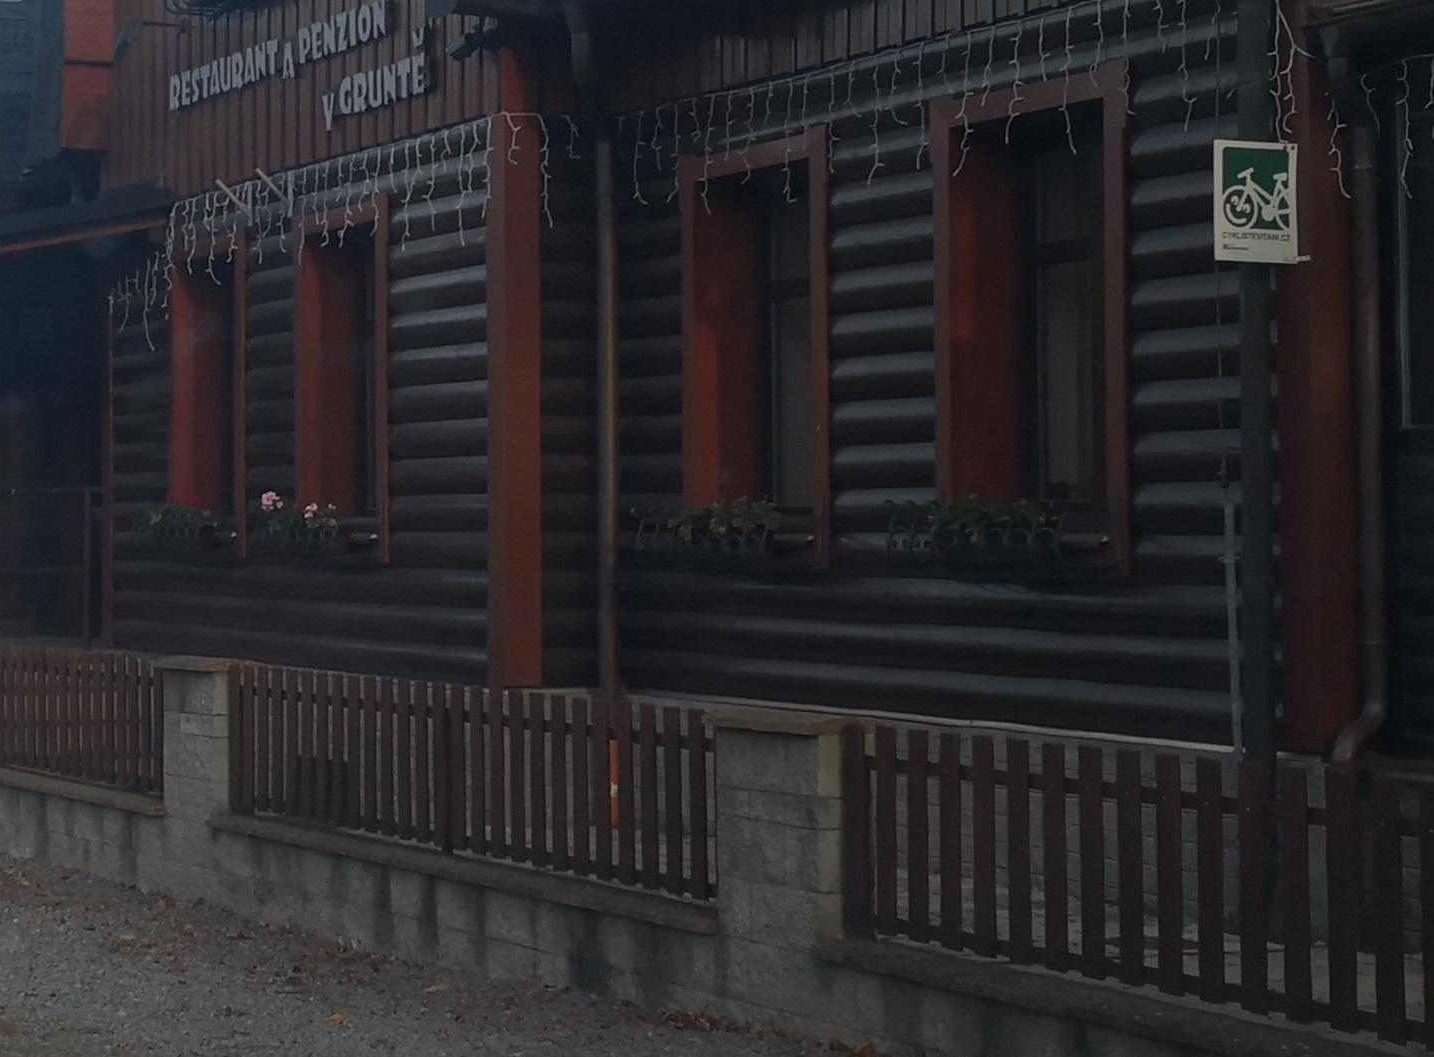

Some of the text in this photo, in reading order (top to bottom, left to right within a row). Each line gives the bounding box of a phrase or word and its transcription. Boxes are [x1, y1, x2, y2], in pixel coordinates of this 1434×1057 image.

[169, 39, 278, 111] RESTAURANT
[282, 42, 295, 79] A
[322, 92, 334, 132] V
